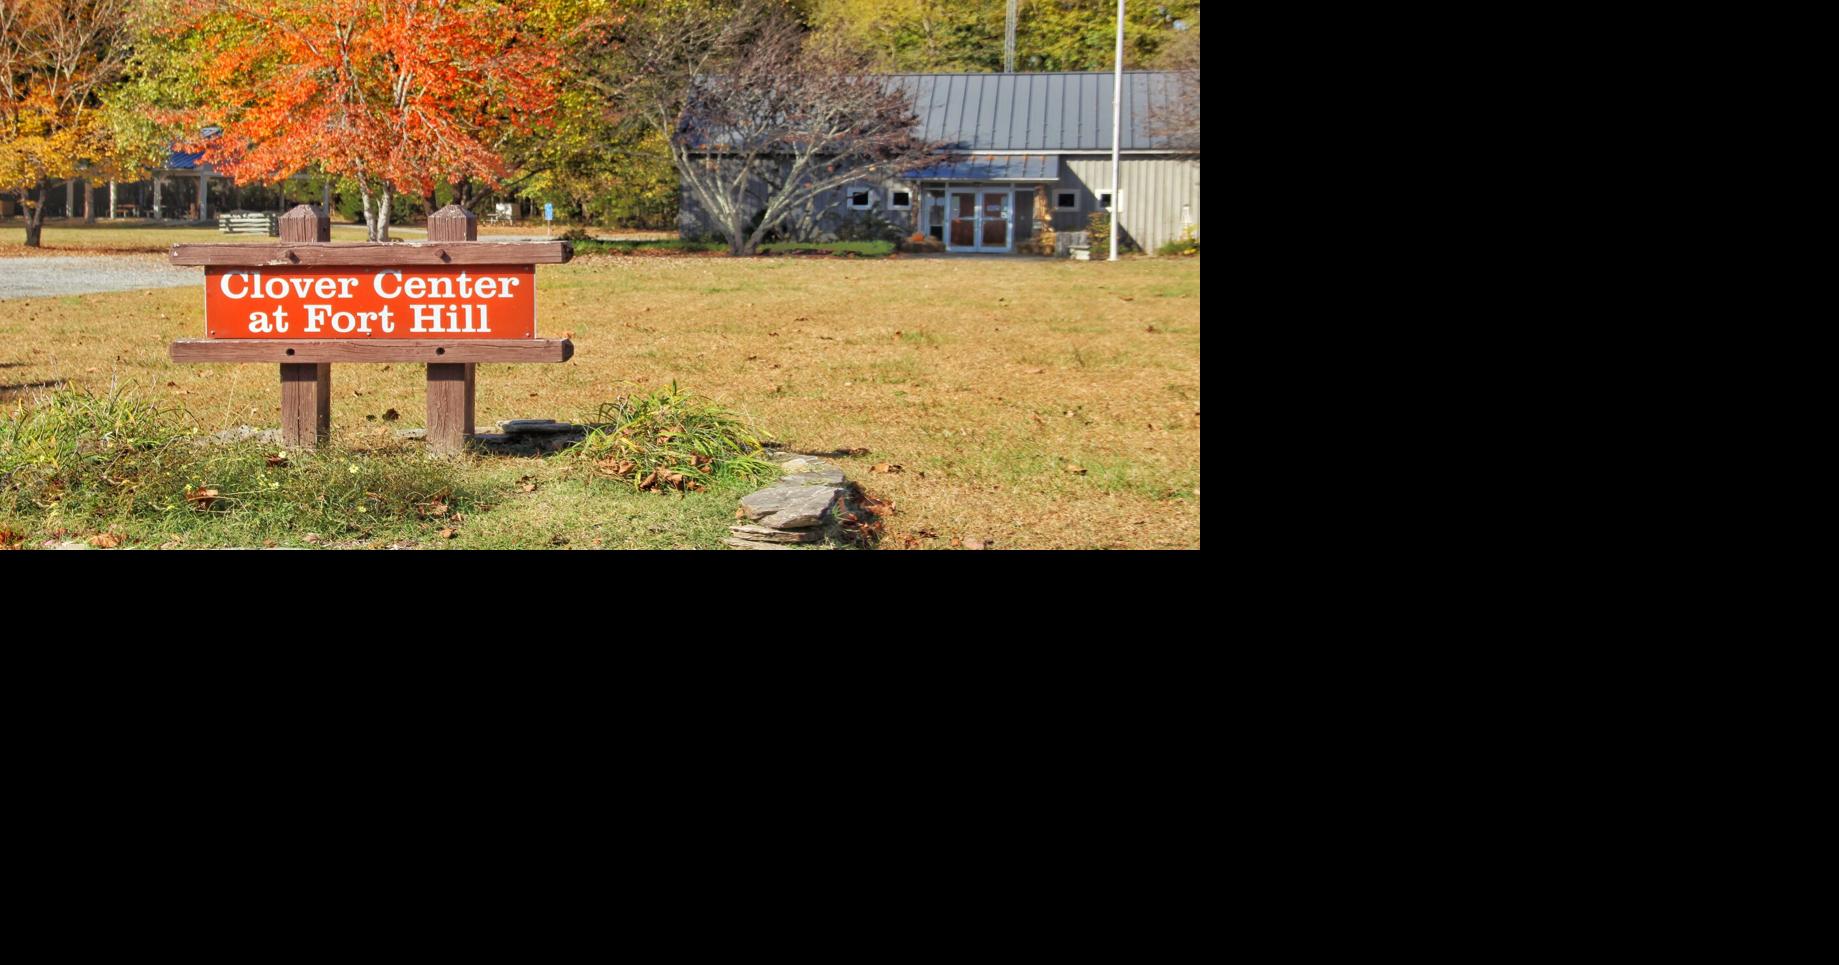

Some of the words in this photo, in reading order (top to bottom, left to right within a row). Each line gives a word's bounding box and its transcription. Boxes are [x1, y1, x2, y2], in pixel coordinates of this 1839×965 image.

[220, 271, 358, 299] Clover
[373, 270, 519, 299] Center
[248, 305, 289, 333] at
[303, 304, 395, 333] Fort
[409, 304, 491, 333] Hill
